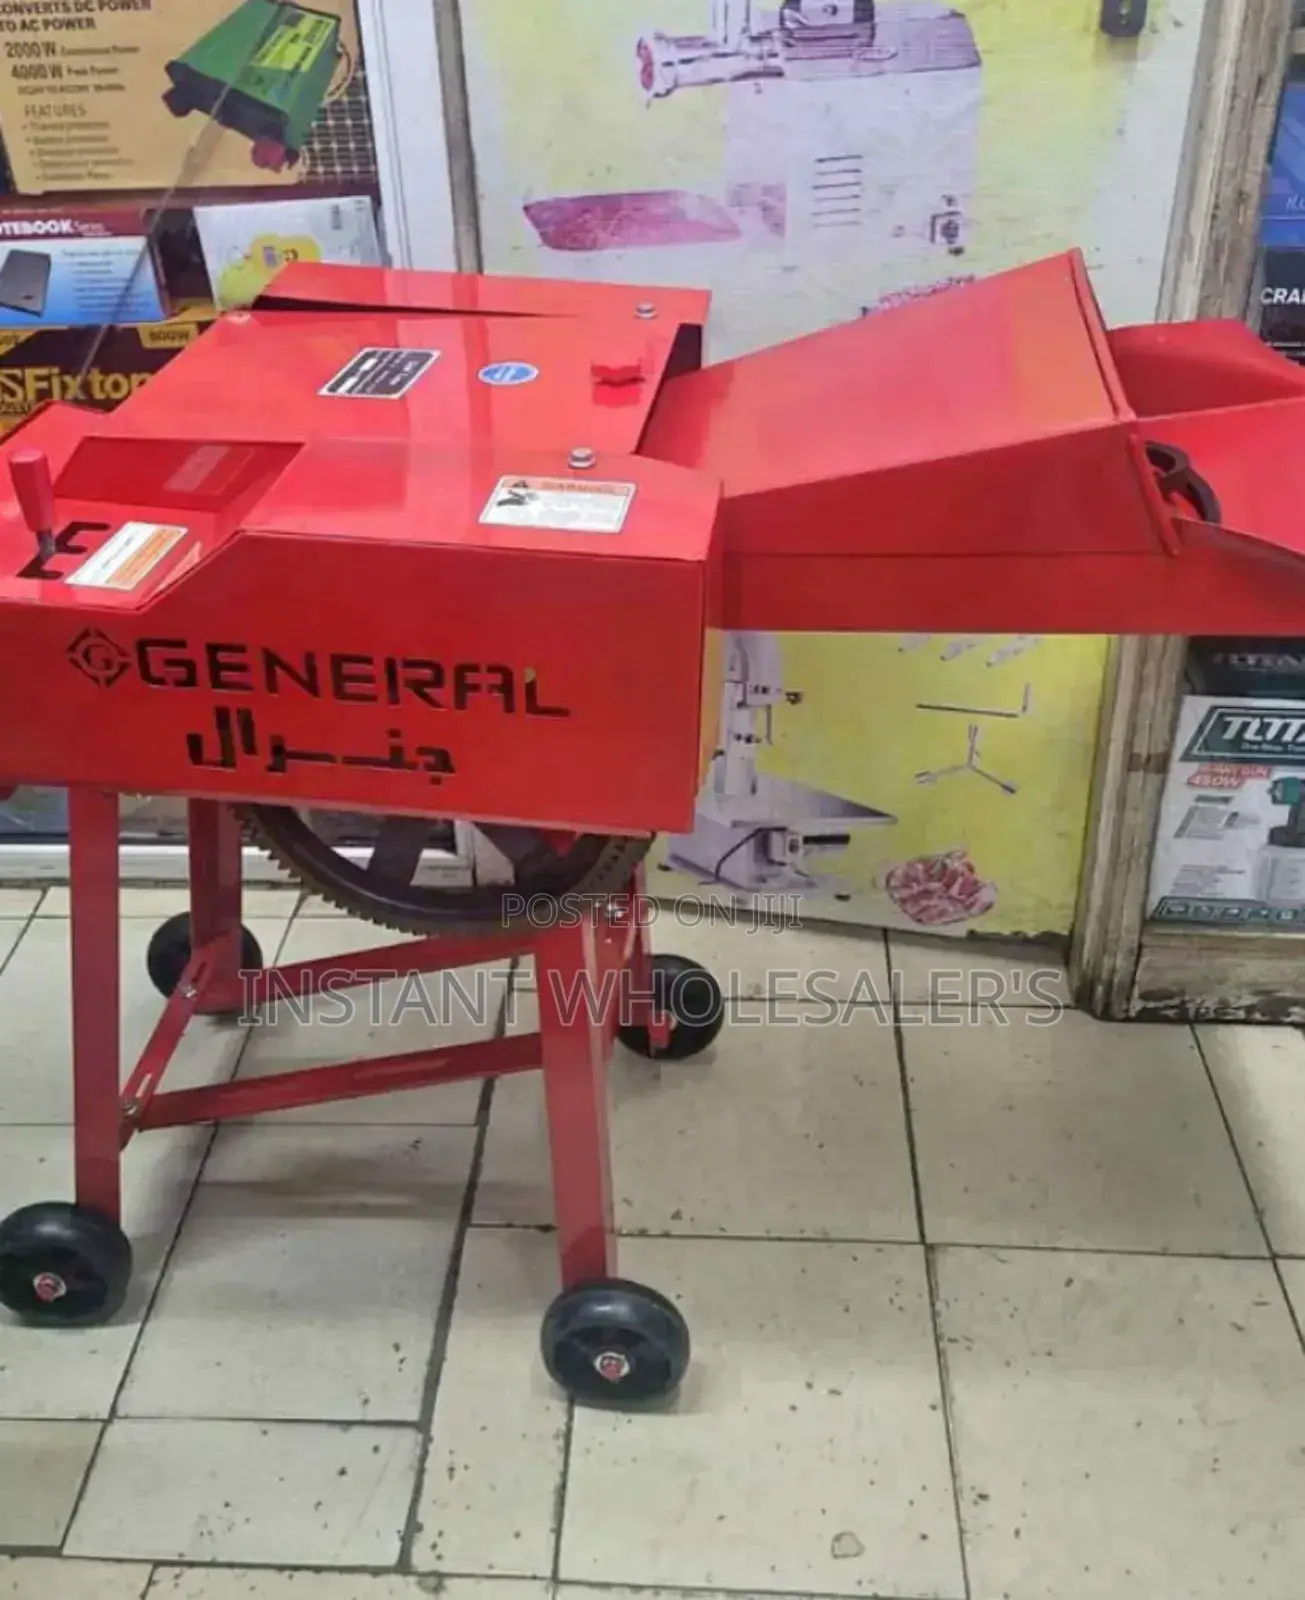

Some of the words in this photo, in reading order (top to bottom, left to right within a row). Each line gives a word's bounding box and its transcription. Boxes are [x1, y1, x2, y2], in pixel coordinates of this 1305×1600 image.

[20, 18, 40, 31] AC
[42, 16, 97, 30] POWER
[5, 41, 41, 58] 2000
[11, 63, 48, 79] 4000
[24, 102, 88, 117] FEATURES
[0, 219, 74, 235] TEBOOK
[1260, 286, 1305, 305] CRA
[135, 637, 571, 719] GENERAL
[186, 704, 456, 786] جنرال
